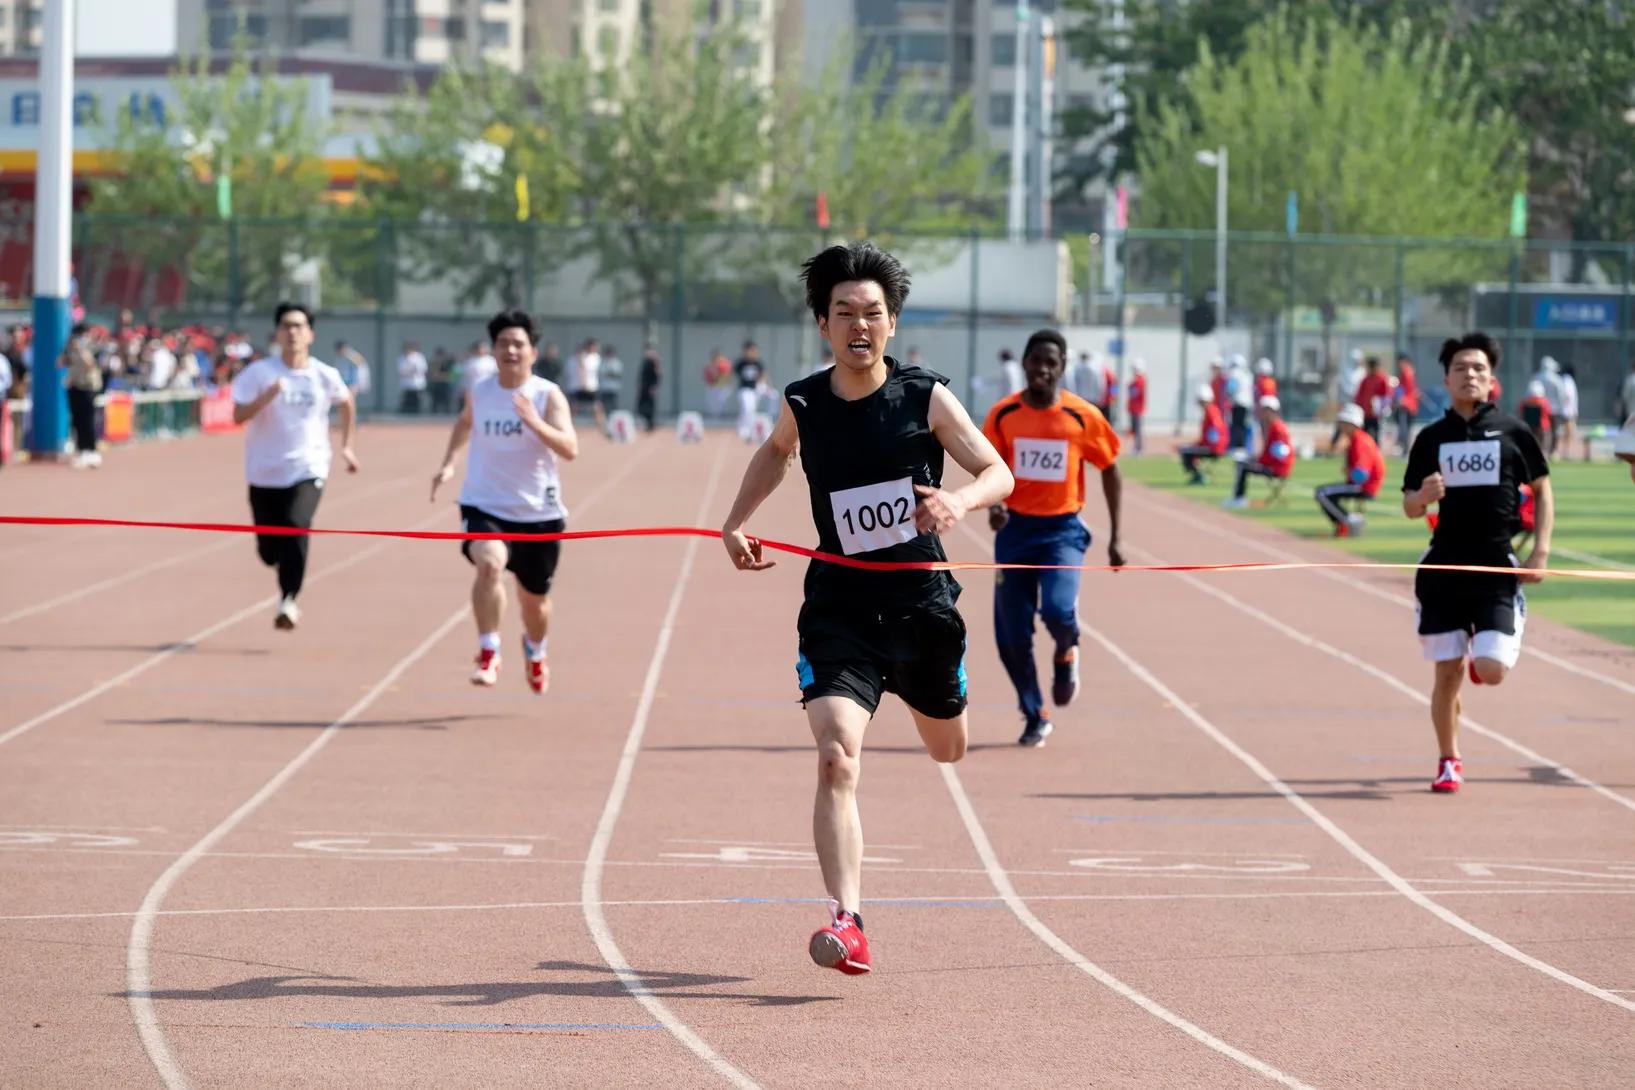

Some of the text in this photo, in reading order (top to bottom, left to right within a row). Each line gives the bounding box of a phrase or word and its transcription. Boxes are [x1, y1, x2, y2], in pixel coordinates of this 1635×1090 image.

[484, 419, 523, 437] 1104
[1020, 450, 1063, 470] 1762
[1446, 452, 1496, 473] 1686
[842, 496, 911, 535] 1002
